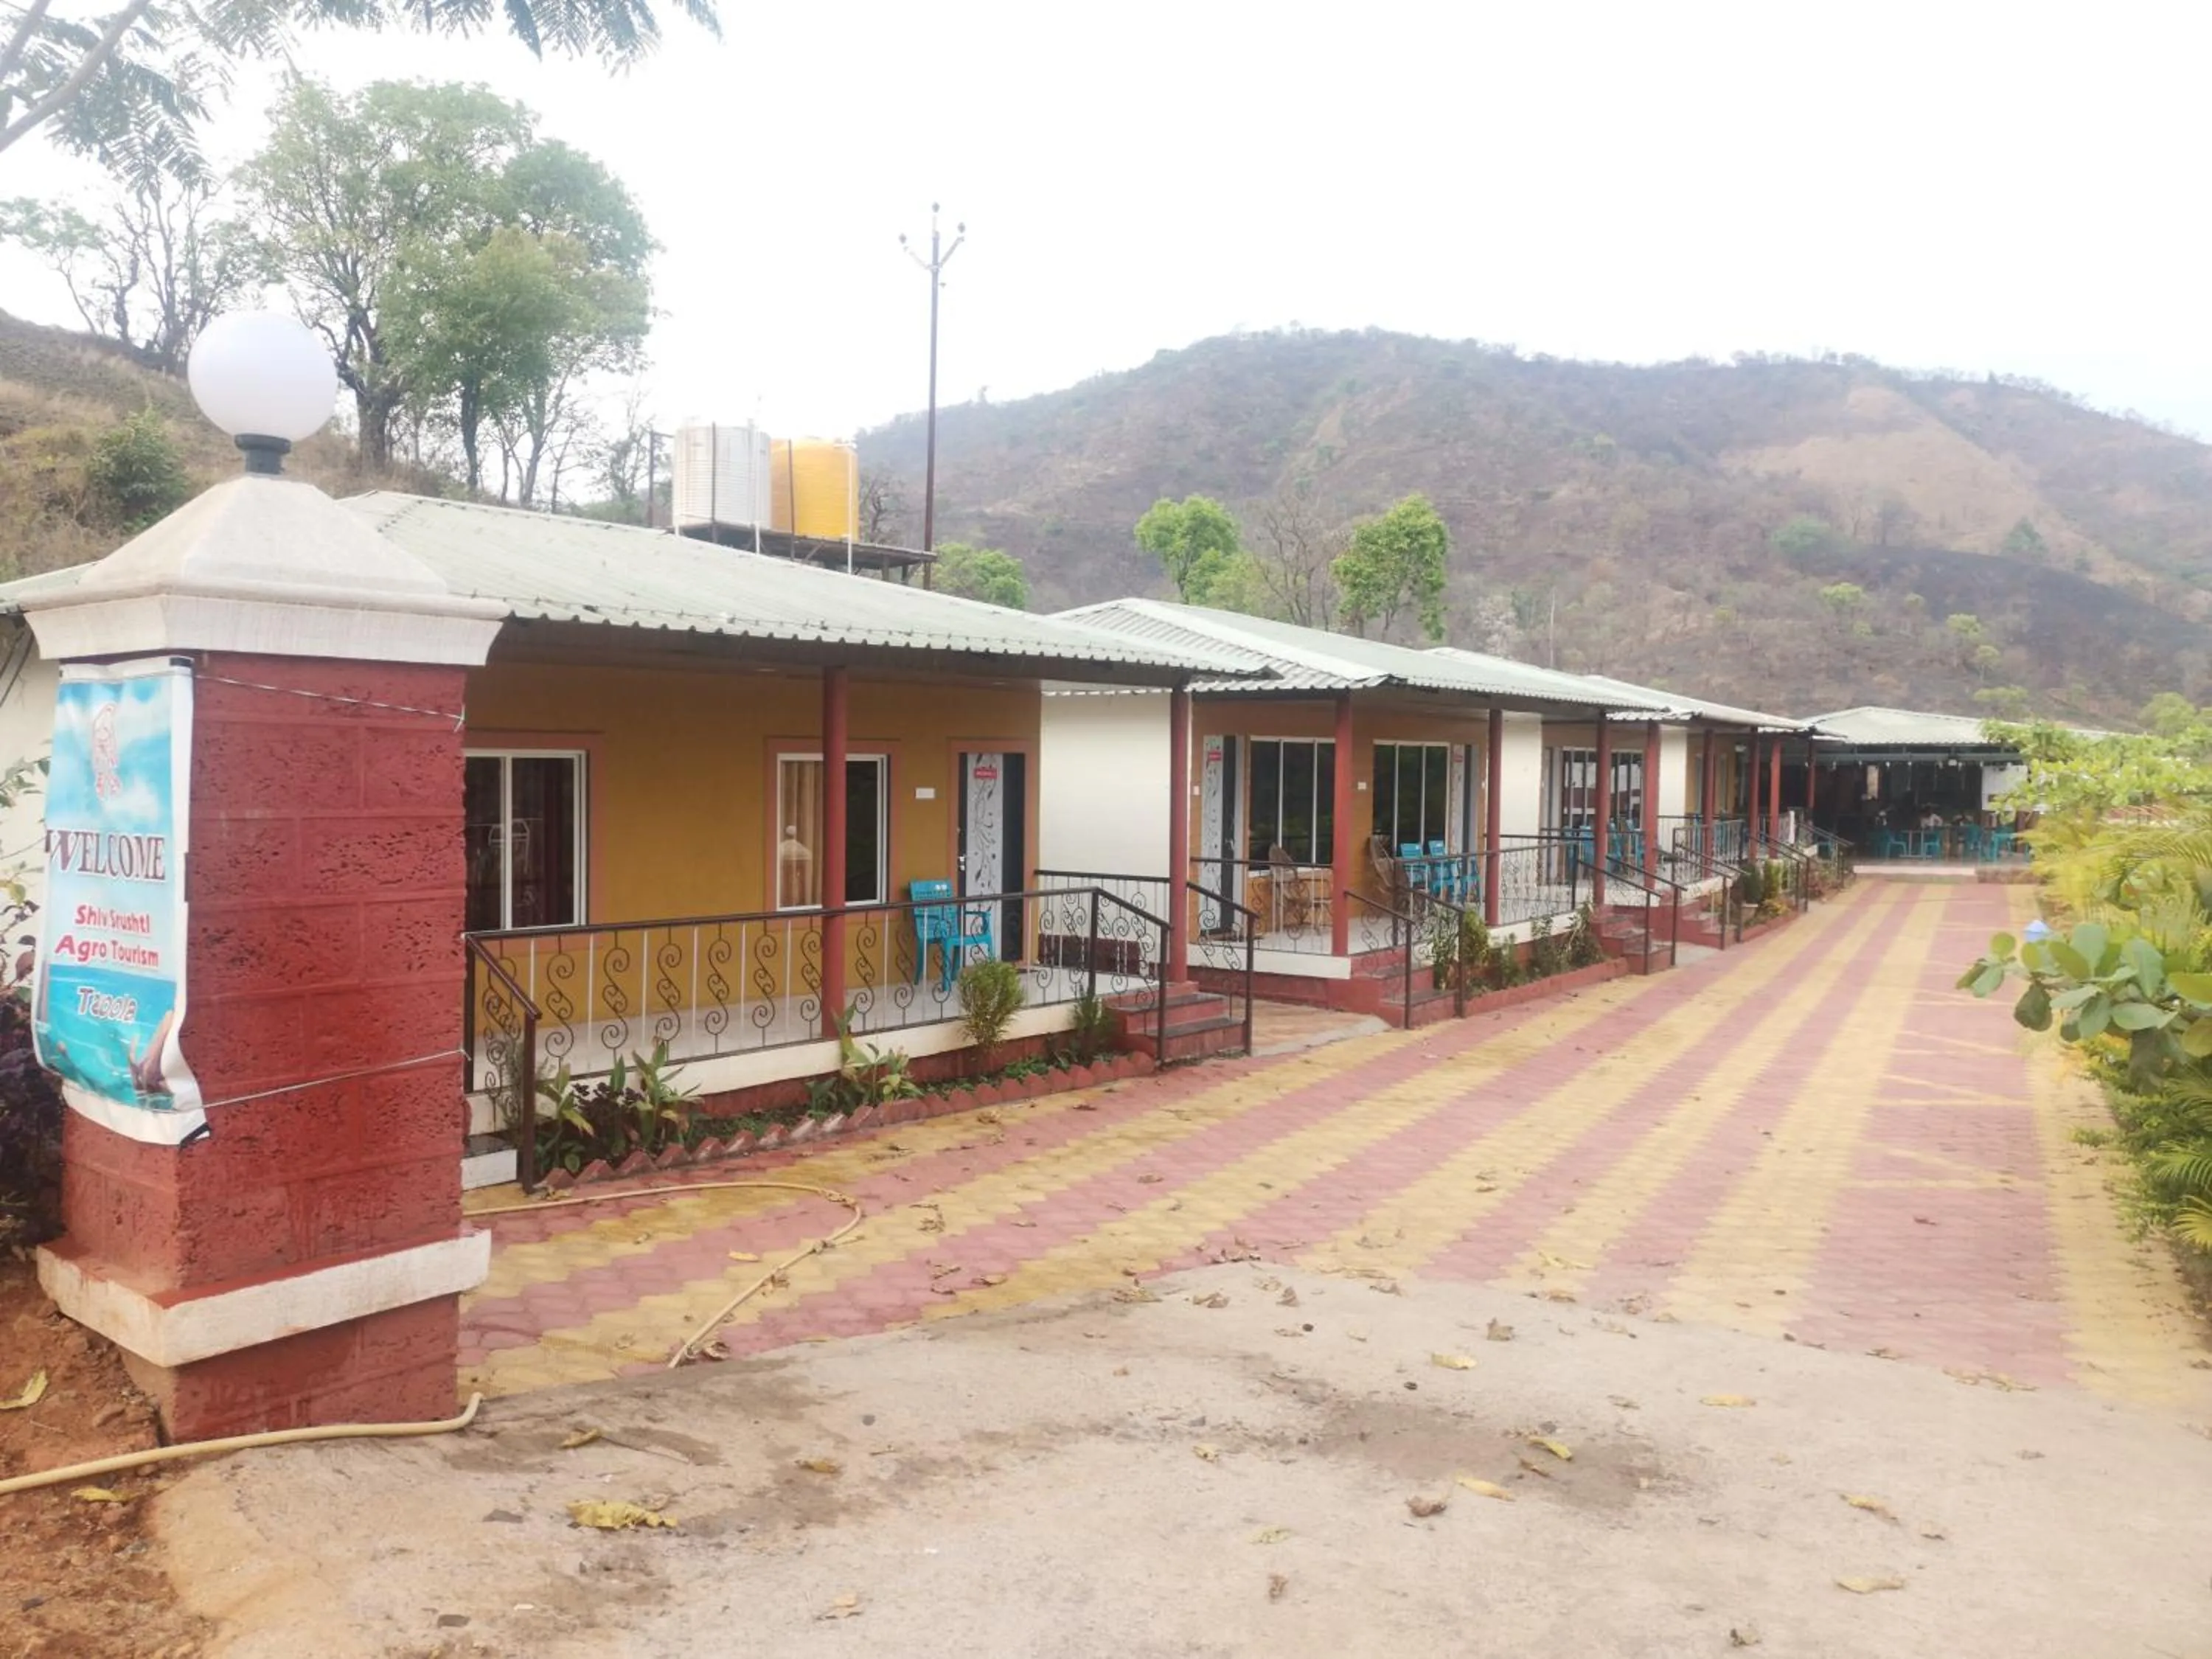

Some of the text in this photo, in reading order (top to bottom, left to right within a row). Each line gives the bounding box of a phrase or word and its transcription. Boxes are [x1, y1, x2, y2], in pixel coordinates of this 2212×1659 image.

[45, 829, 166, 881] WELCOME
[74, 904, 108, 927] Shiv
[55, 934, 159, 967] Agro Tourism
